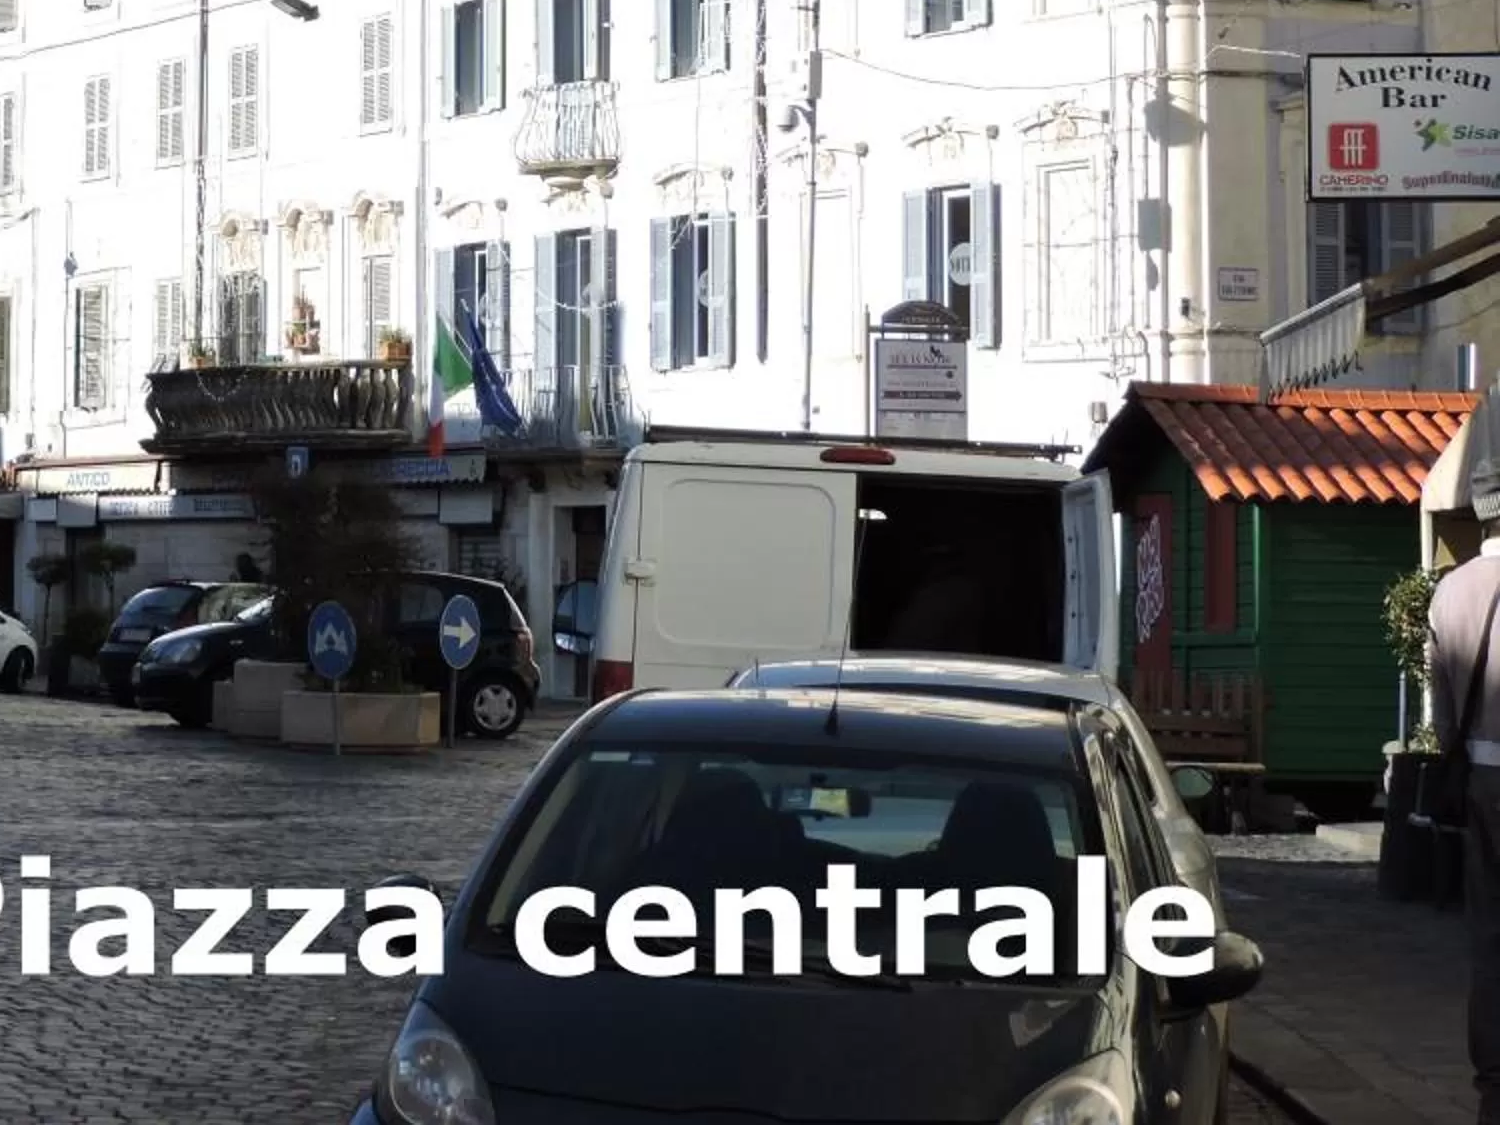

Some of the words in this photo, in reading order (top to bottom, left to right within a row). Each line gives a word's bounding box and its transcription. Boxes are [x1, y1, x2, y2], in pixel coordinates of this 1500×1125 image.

[1336, 58, 1492, 92] American
[1381, 86, 1447, 109] Bar
[66, 471, 111, 487] ANTICO
